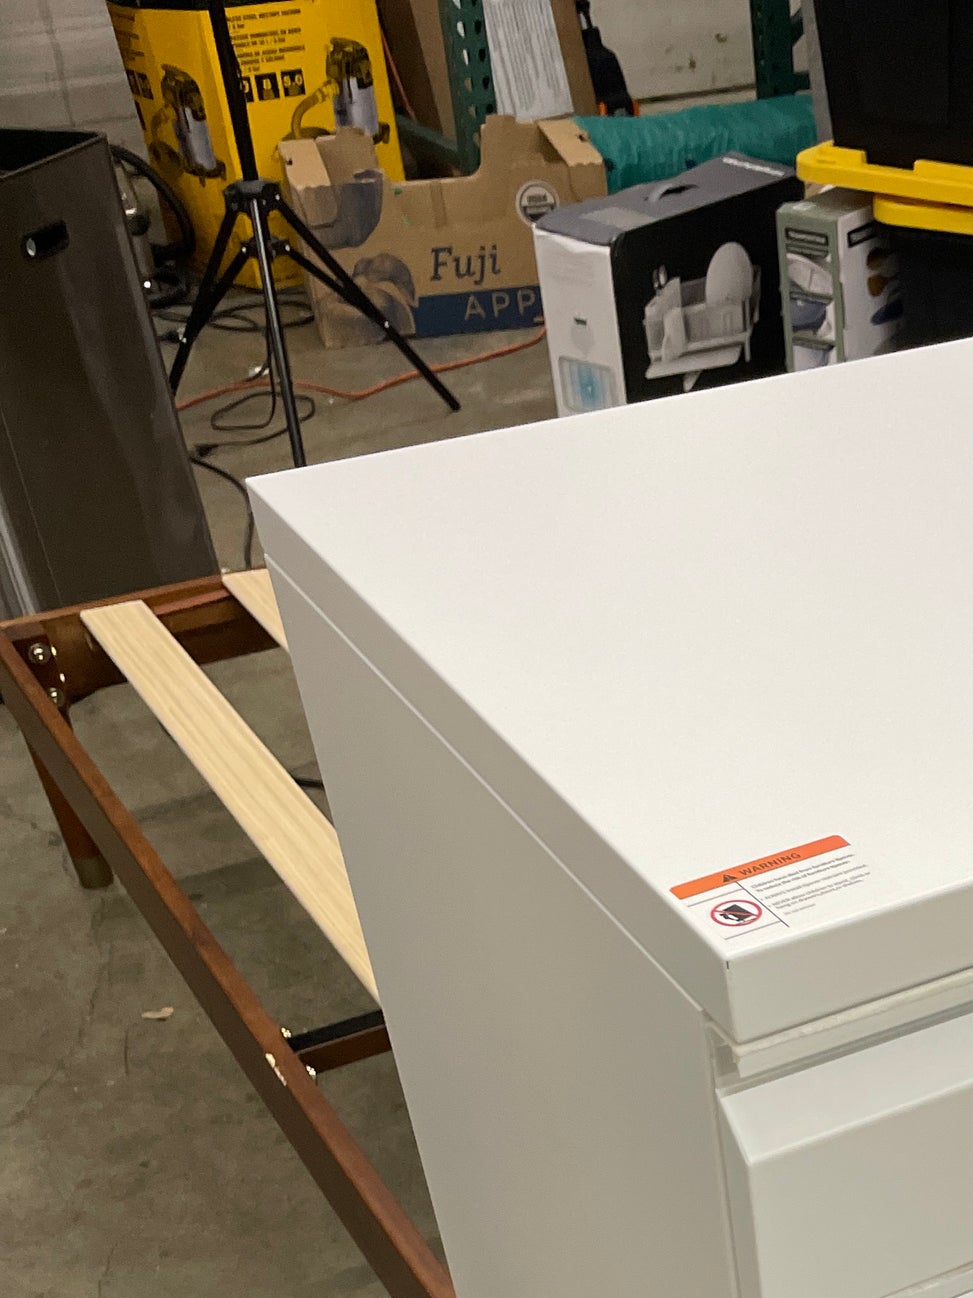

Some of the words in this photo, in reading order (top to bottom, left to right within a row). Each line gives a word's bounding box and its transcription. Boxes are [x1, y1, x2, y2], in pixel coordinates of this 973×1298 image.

[430, 244, 502, 285] Fuji
[464, 289, 536, 321] APP
[739, 852, 801, 876] WARNING
